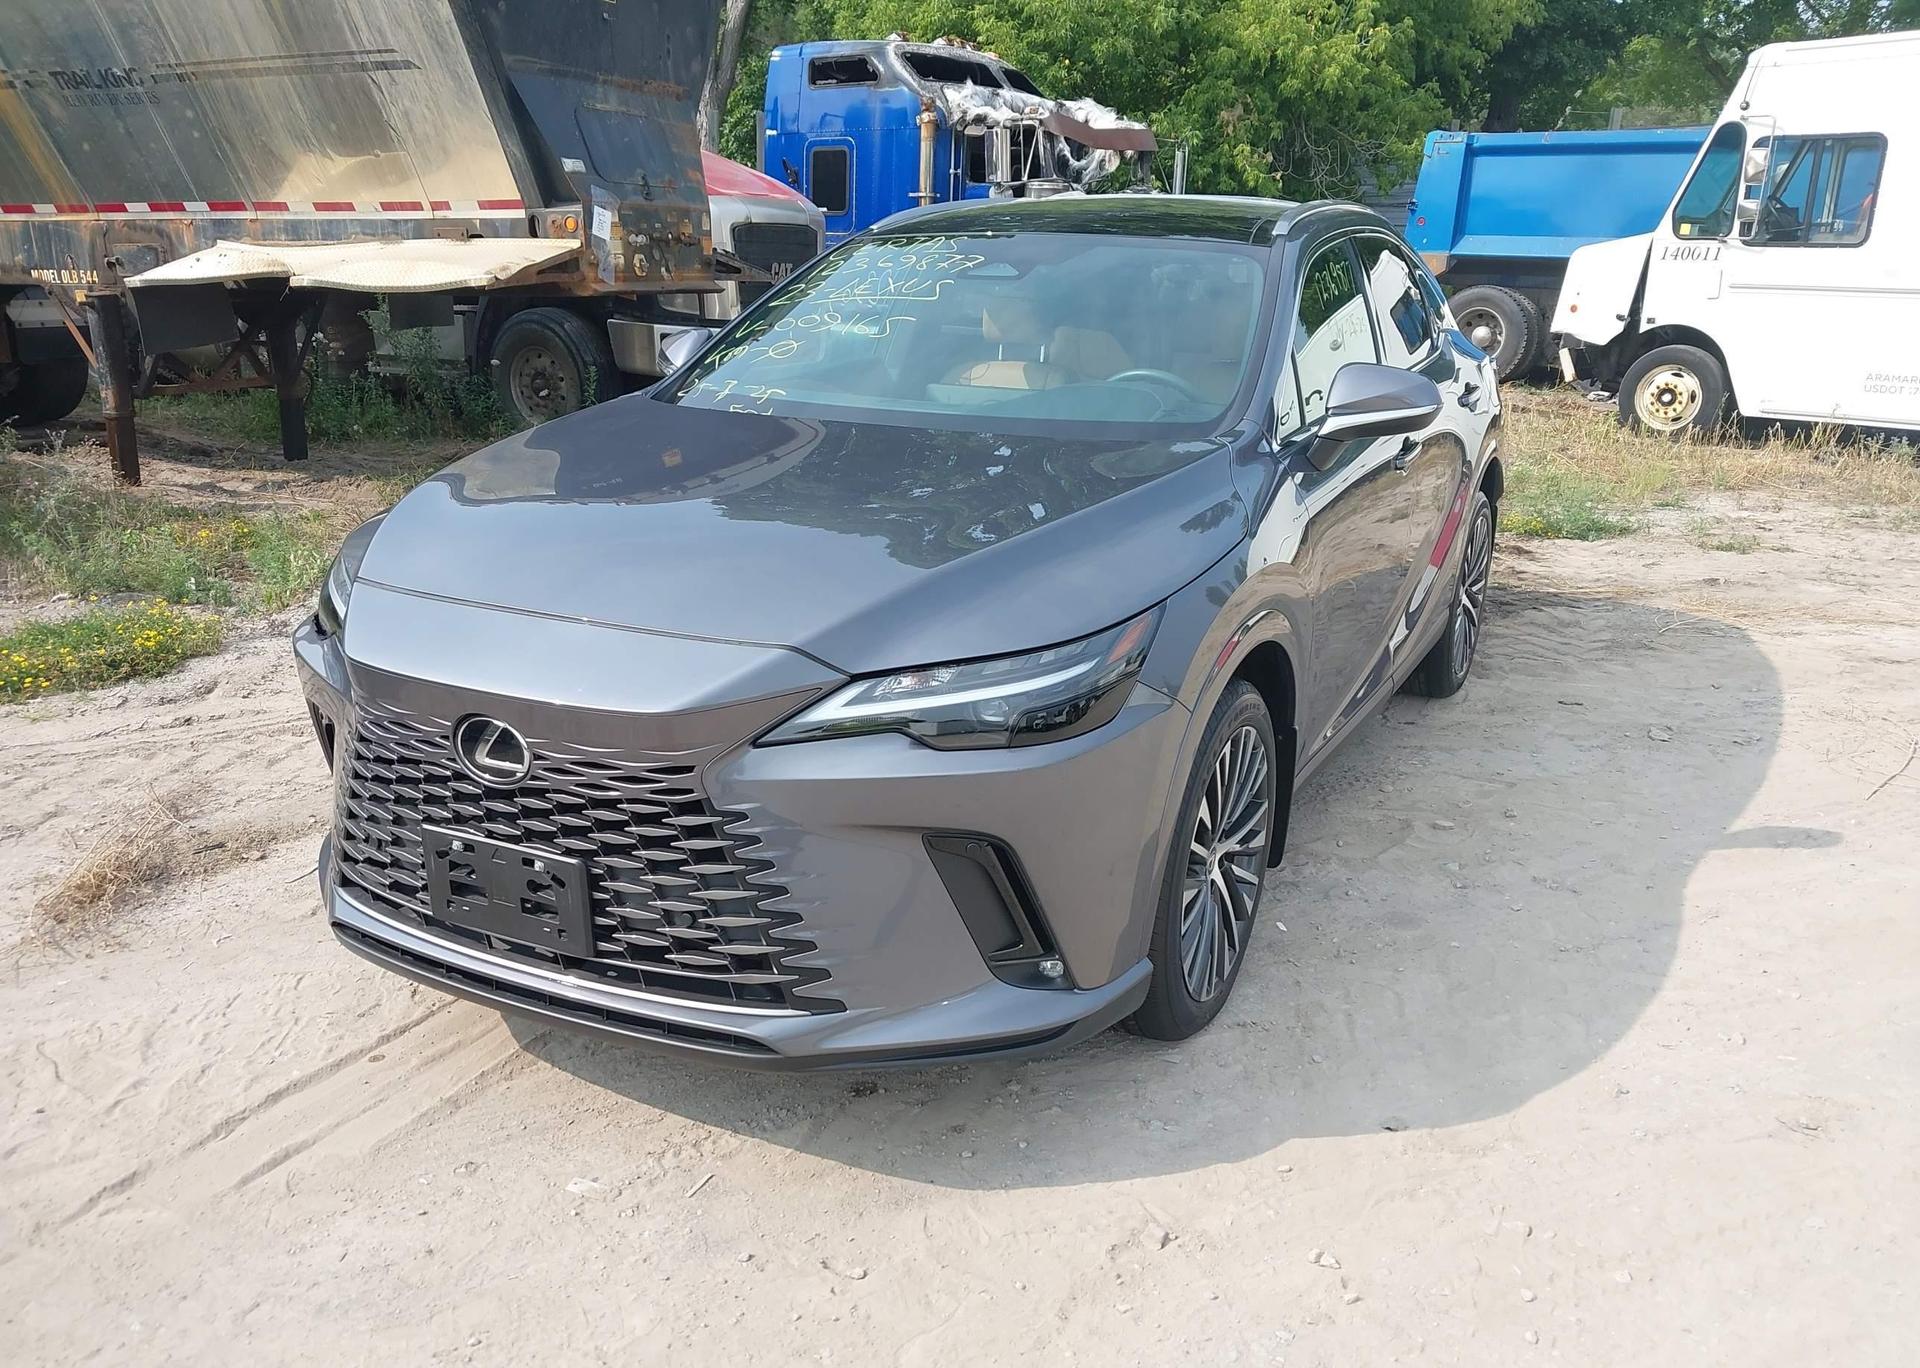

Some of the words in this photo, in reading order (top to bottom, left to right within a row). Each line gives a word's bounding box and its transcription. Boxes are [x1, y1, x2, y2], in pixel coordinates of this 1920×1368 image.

[1660, 246, 1722, 262] 140011
[30, 269, 60, 284] MODEL
[80, 269, 99, 284] 544
[771, 262, 793, 284] CAT
[1865, 372, 1920, 385] ARAMAR
[1864, 384, 1906, 395] USDOT
